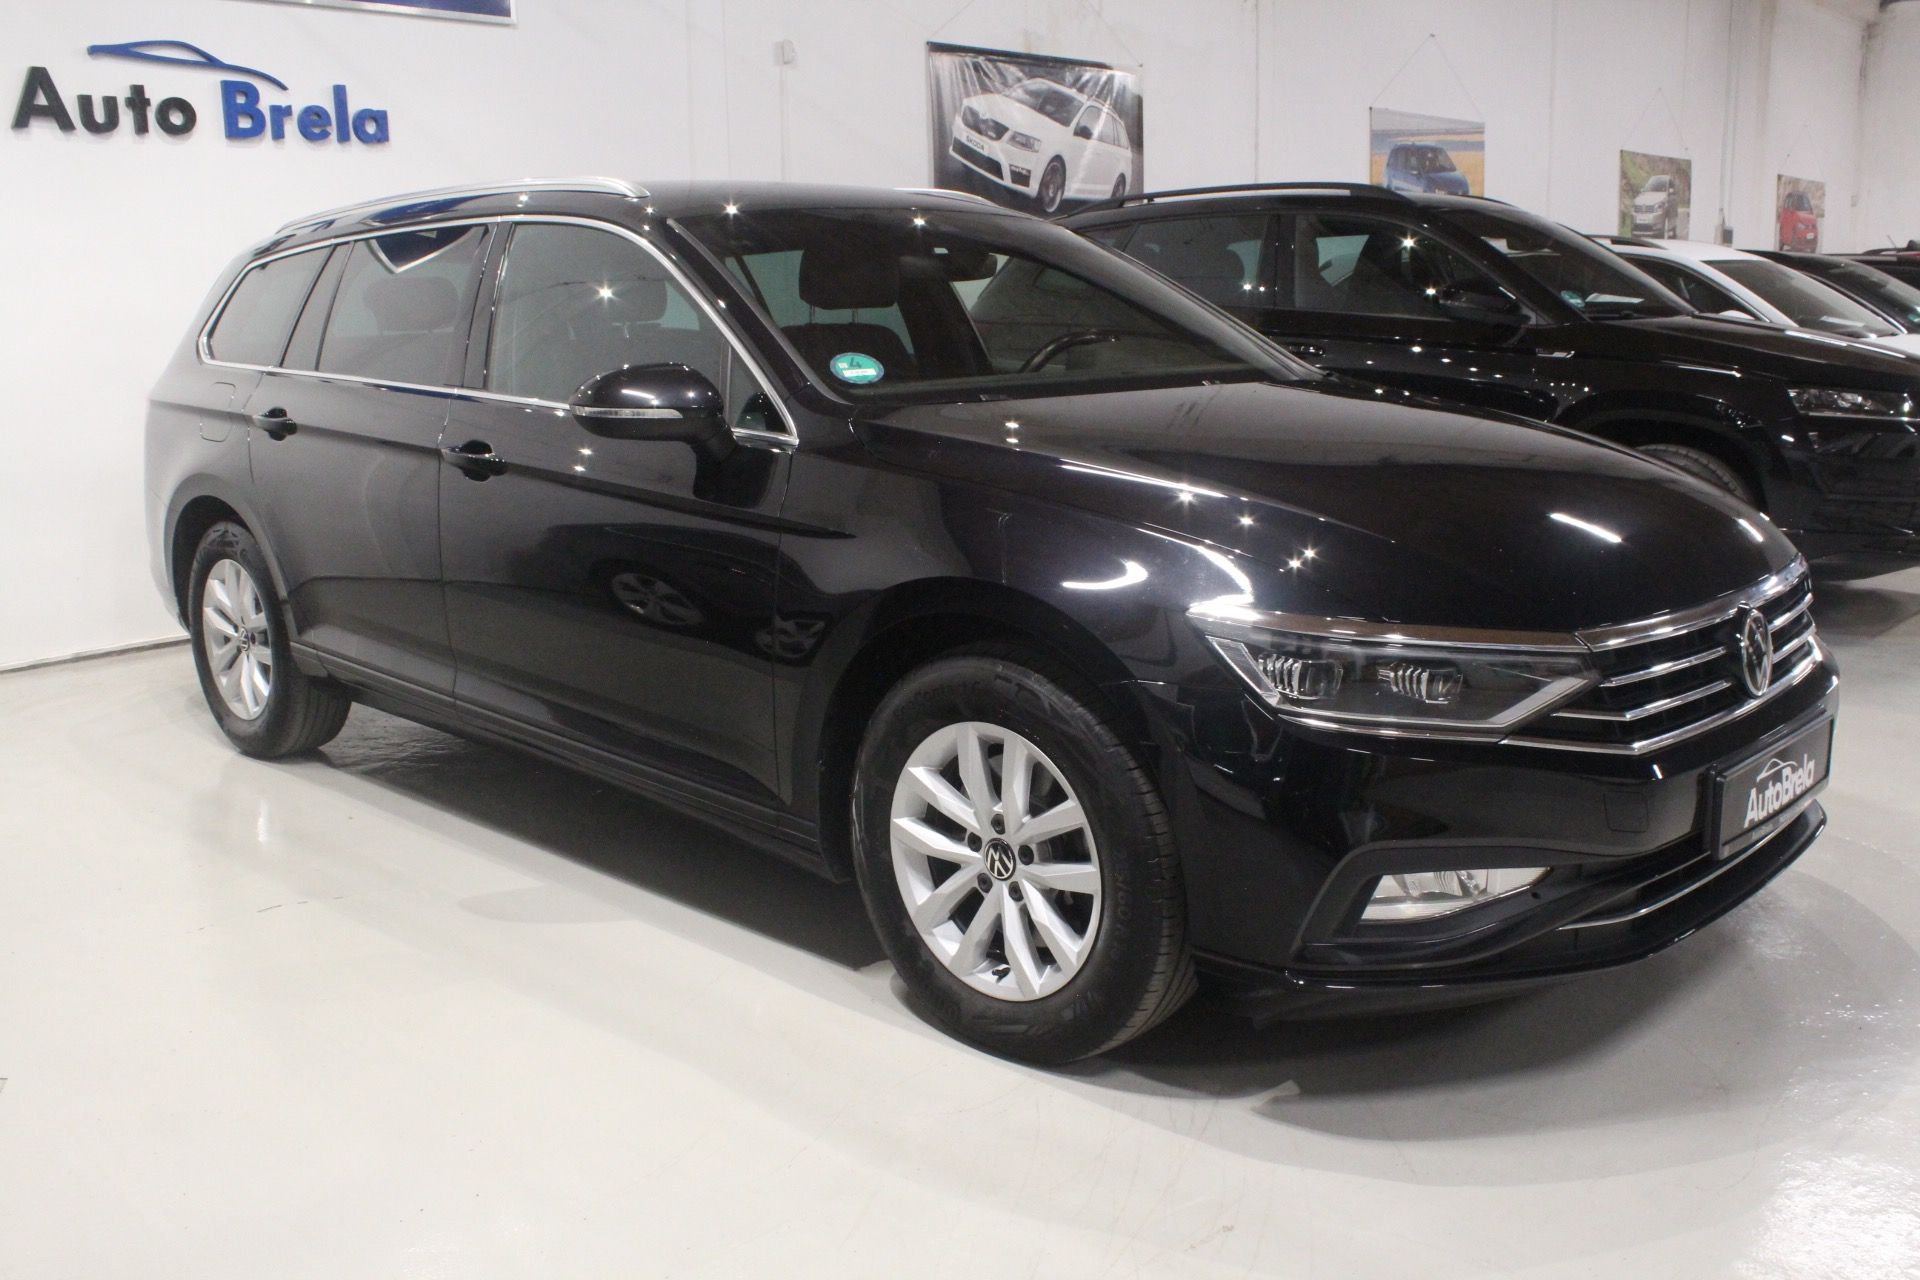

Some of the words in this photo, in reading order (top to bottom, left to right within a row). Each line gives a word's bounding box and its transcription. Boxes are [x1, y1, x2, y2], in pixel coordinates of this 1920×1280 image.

[11, 66, 197, 136] Auto
[220, 80, 390, 144] Brela
[1743, 753, 1816, 829] AutoBrela
